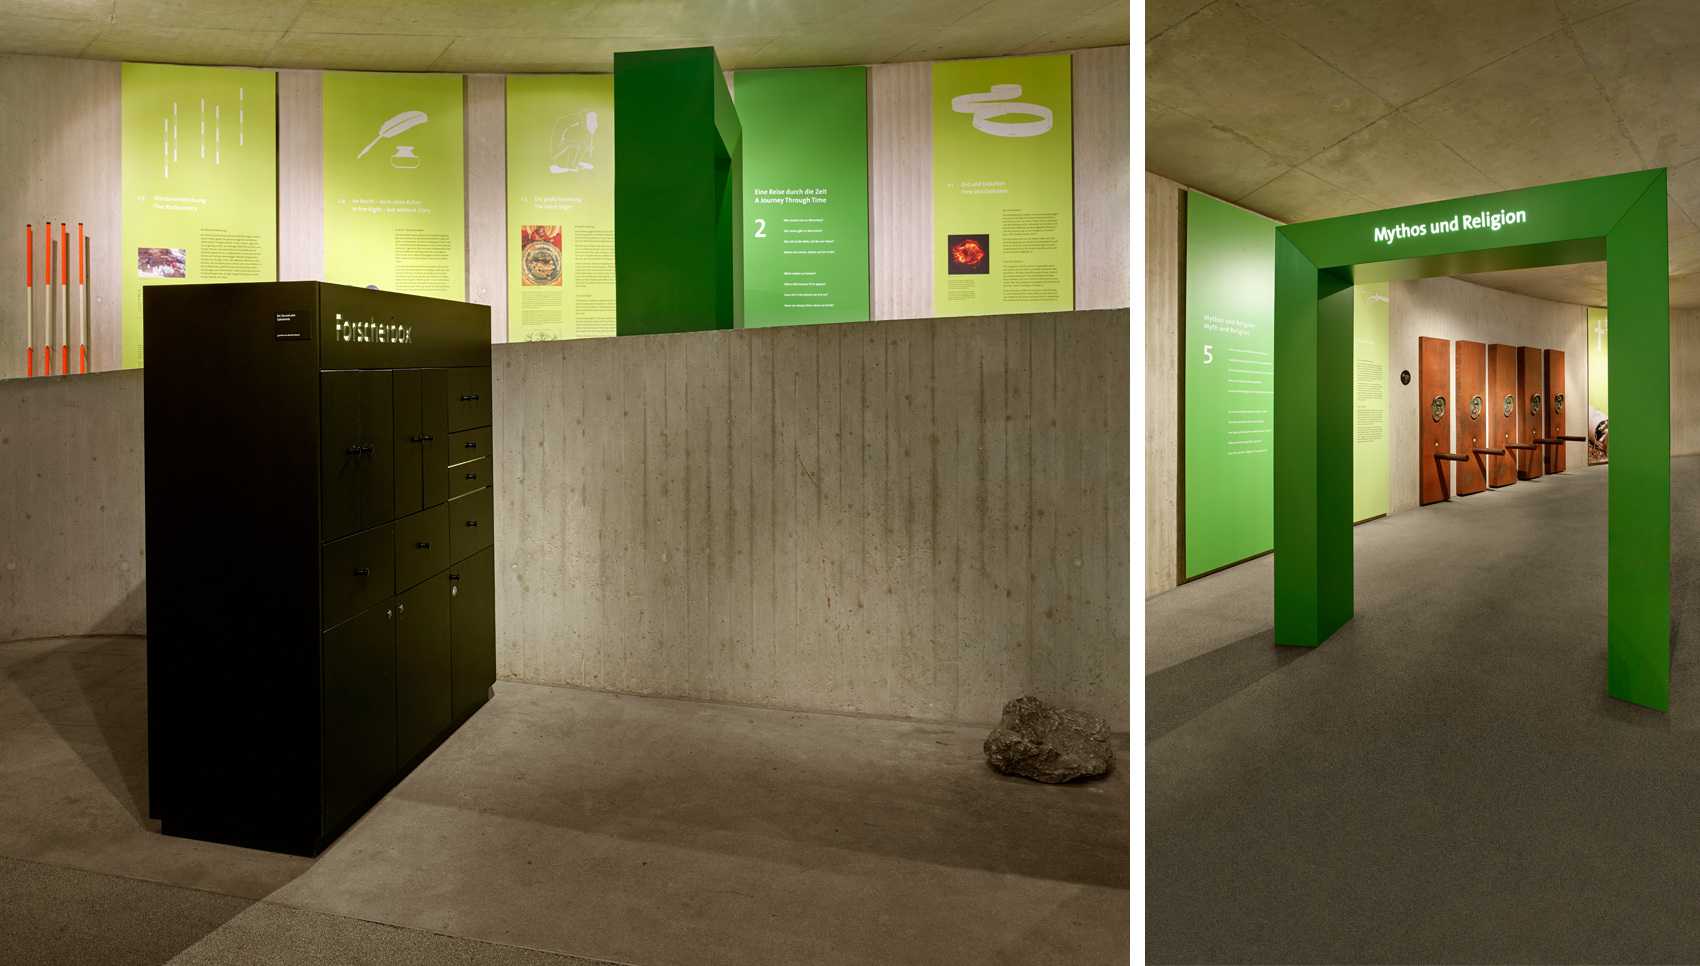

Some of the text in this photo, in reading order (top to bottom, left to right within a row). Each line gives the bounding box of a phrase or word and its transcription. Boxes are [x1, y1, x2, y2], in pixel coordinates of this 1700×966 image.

[153, 196, 206, 204] Wiederentdeckung
[165, 204, 198, 212] Rediscovery
[755, 218, 766, 238] 2
[1374, 210, 1526, 244] Mythos und Religion
[336, 314, 412, 344] Forscherbox
[1204, 315, 1224, 323] Mythos
[1236, 320, 1256, 329] Religion
[1204, 323, 1218, 331] Myth
[1230, 327, 1250, 336] Religion
[1204, 345, 1213, 364] 5
